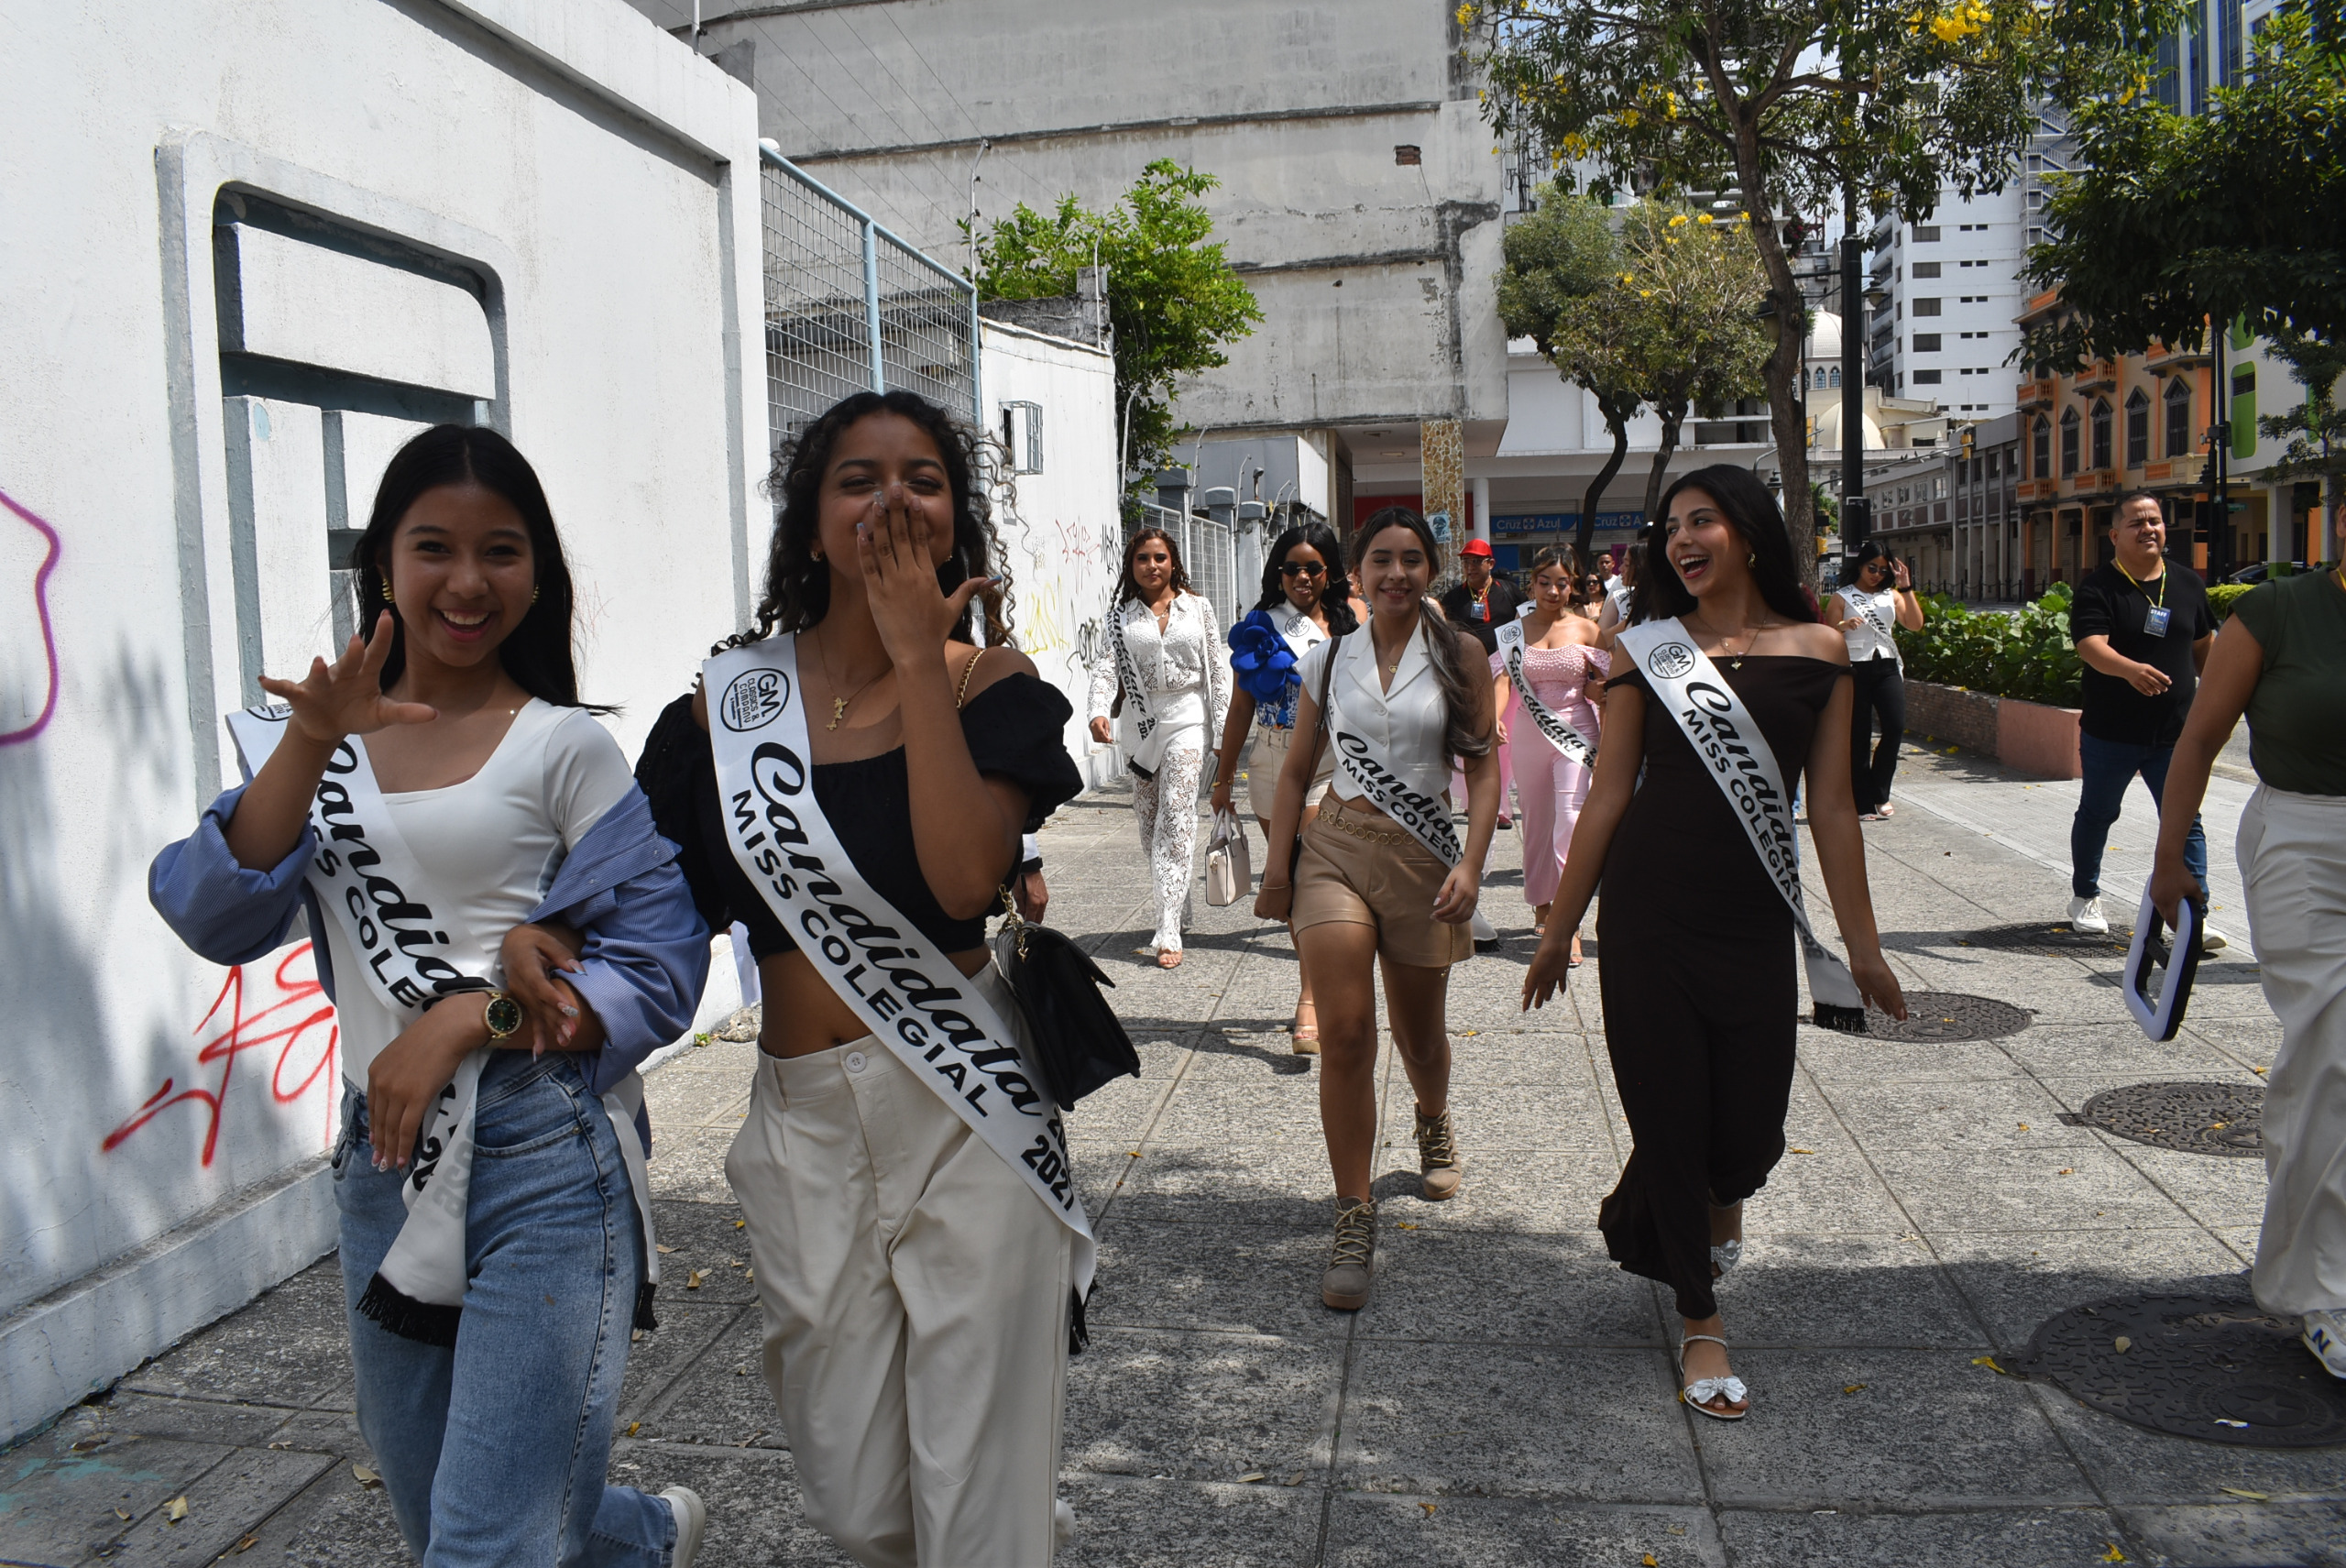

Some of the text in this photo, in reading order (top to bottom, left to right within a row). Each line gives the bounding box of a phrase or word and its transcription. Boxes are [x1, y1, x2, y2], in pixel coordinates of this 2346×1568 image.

[1496, 517, 1562, 531] Cruz Azul
[2150, 609, 2167, 618] STAFF
[757, 673, 781, 718] GM
[1113, 641, 1135, 709] COLEGIAL
[1669, 645, 1691, 670] GM
[1336, 731, 1464, 859] Candida
[1583, 754, 1595, 769] 20
[1342, 758, 1460, 865] MISS COLEGI
[1682, 708, 1803, 911] MISS COLEGIAL
[345, 885, 445, 1014] COLE
[732, 789, 988, 1118] MISS COLEGIAL
[751, 741, 1042, 1116] Candidata
